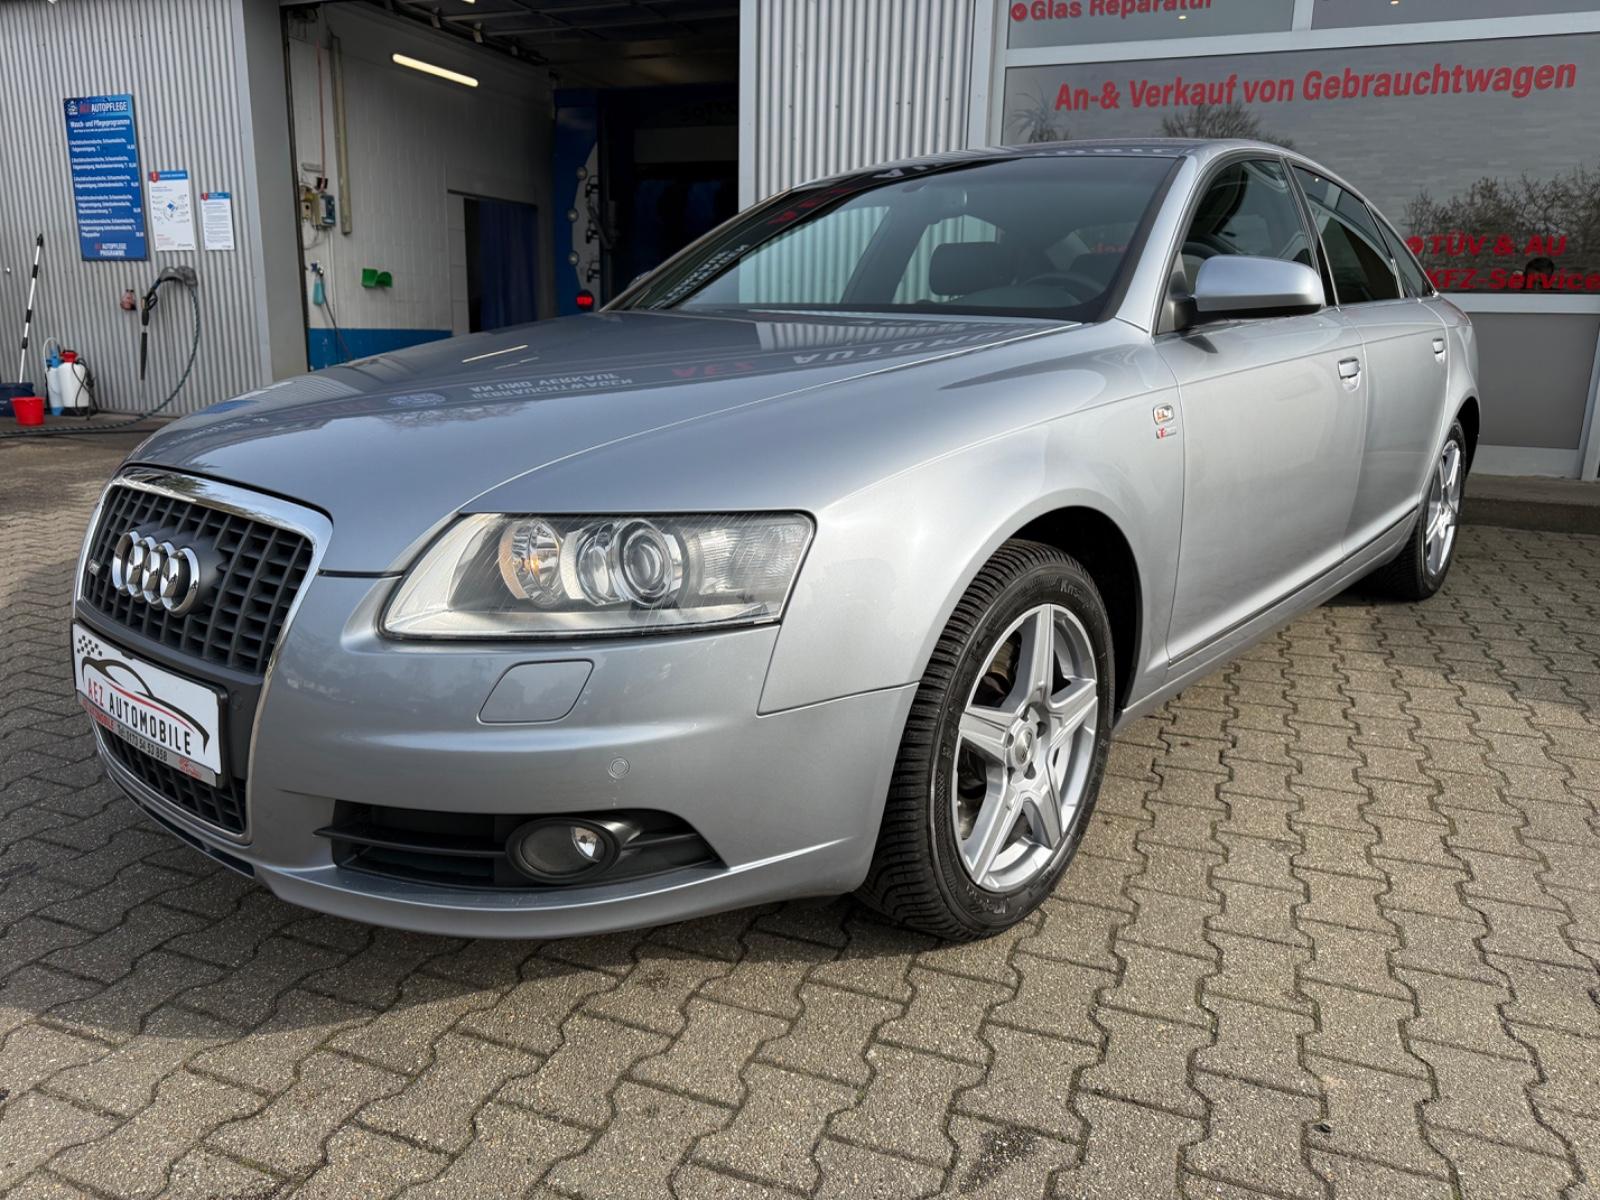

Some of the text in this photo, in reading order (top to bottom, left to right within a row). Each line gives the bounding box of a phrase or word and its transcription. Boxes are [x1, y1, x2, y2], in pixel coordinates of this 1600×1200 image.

[1030, 0, 1211, 20] Glas Reparatur
[1056, 63, 1577, 111] An-& Verkauf von Gebrauchtwagen
[91, 102, 128, 112] AUTOPFLEGE
[1430, 229, 1568, 256] TÜV & AU
[1426, 267, 1600, 290] KFZ-Service
[88, 677, 192, 756] AEZ AUTOMOBILE
